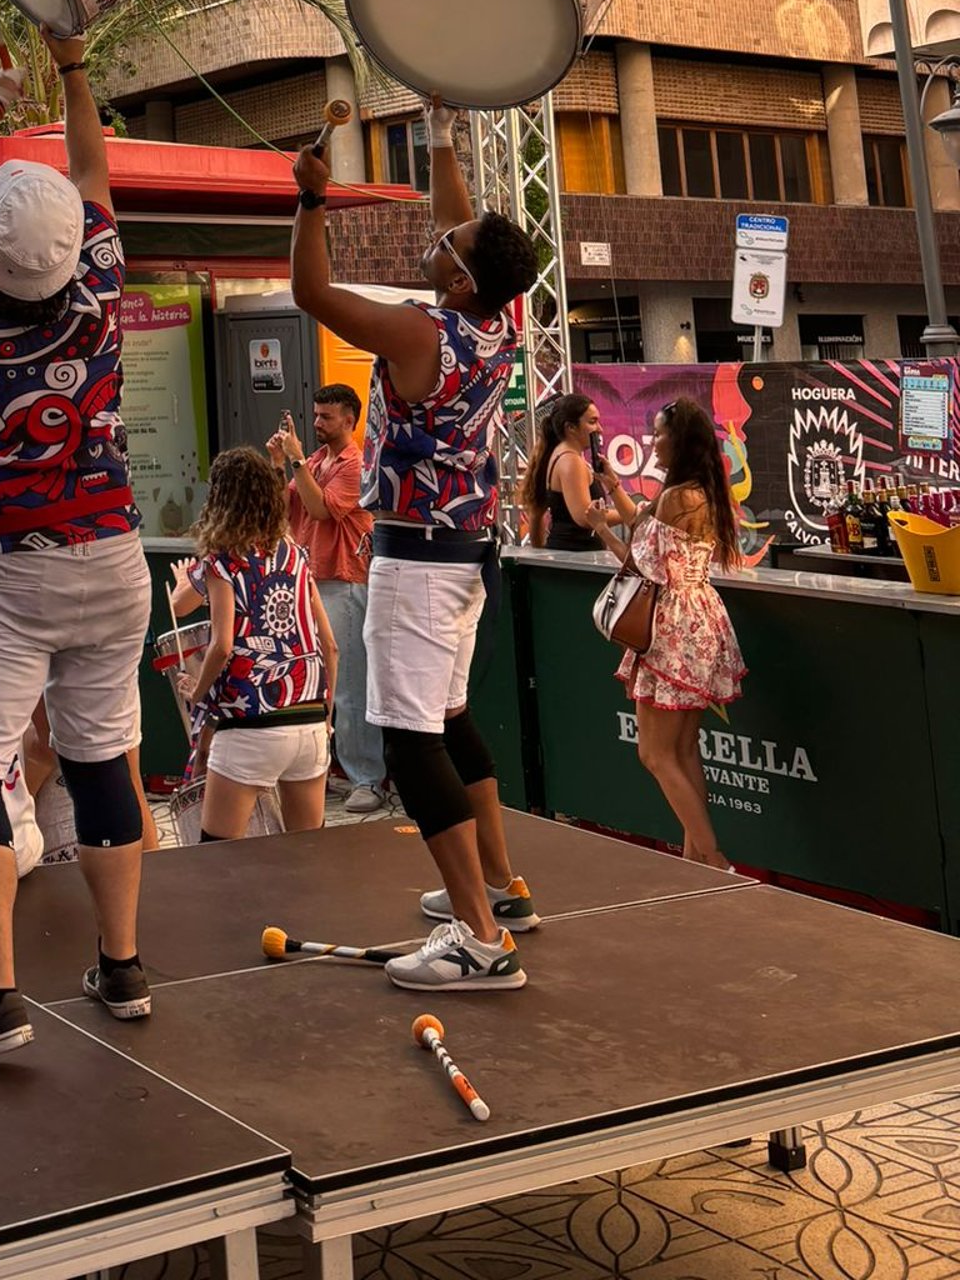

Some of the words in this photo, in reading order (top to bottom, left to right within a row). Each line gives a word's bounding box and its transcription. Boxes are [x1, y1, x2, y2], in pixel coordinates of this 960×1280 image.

[740, 222, 783, 231] TRADICIONAL
[748, 216, 776, 224] CENTRO
[792, 387, 856, 402] HOGUERA
[784, 510, 821, 545] CALVO
[729, 797, 762, 815] 1963
